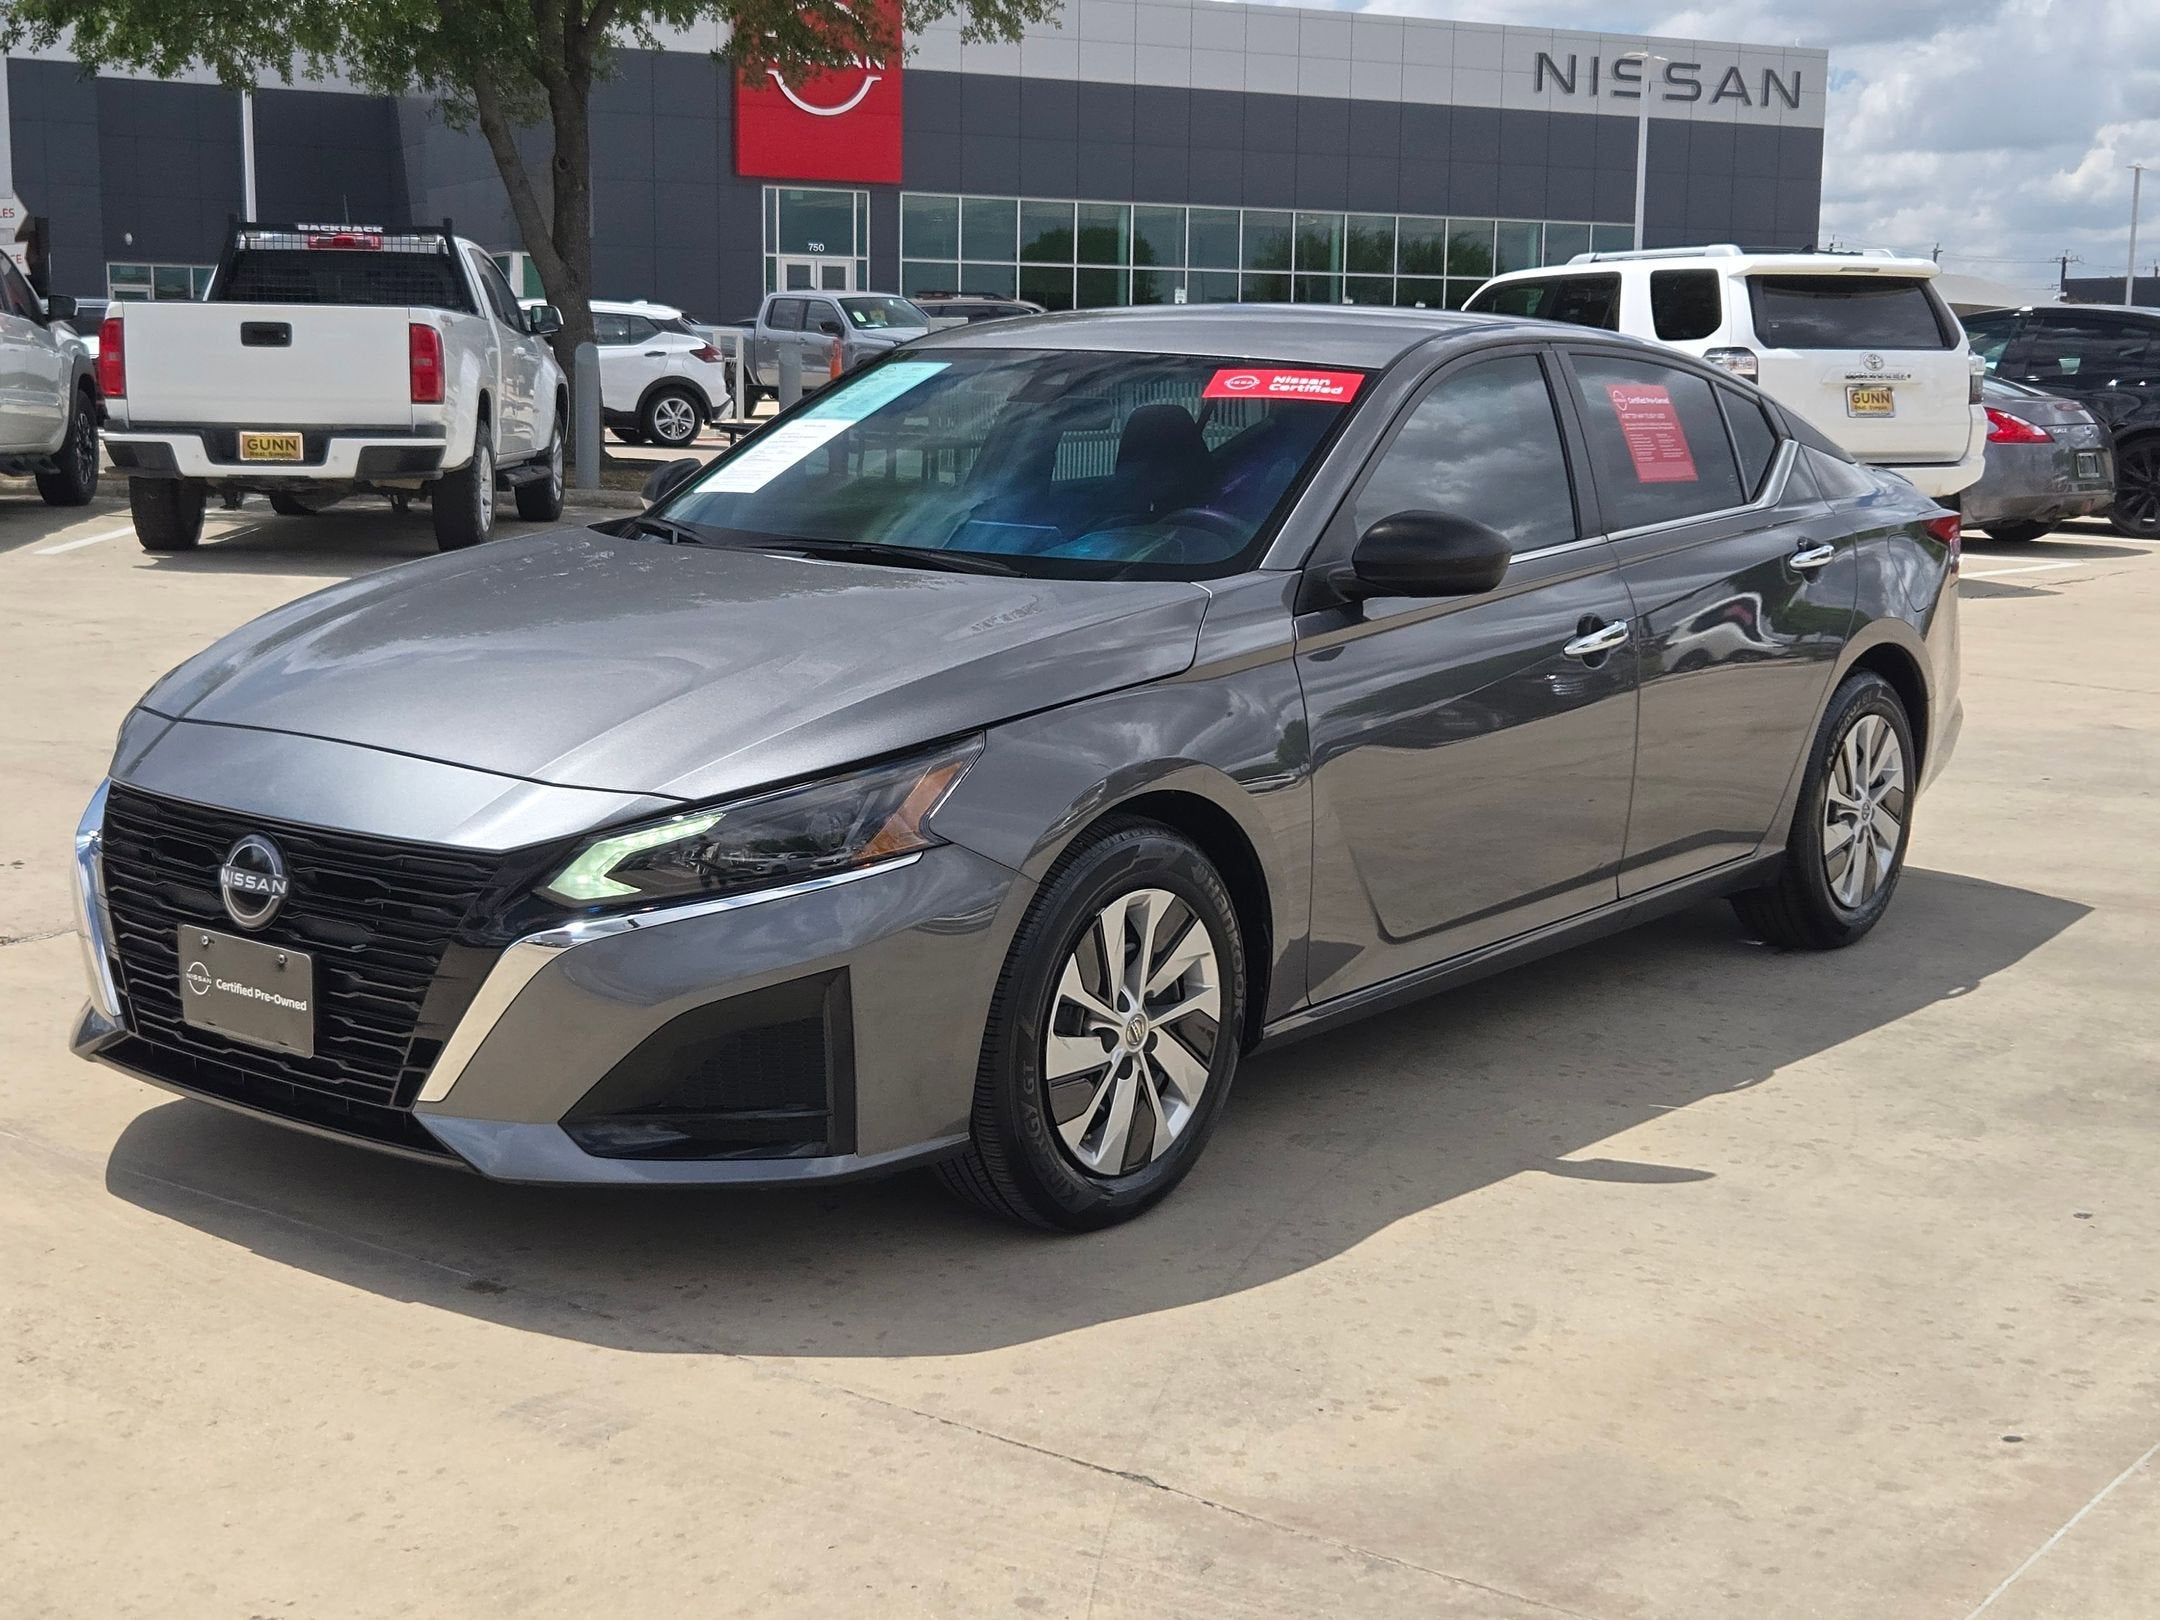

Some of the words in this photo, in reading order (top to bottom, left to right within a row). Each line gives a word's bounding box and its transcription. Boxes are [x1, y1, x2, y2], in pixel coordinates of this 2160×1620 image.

[1534, 52, 1802, 109] NISSAN
[297, 223, 385, 234] BACKRACK
[808, 242, 825, 252] 750
[1272, 375, 1331, 386] Nissan
[1268, 383, 1344, 395] Certified
[1852, 392, 1890, 404] GUNN
[247, 438, 297, 451] GUNN
[221, 867, 288, 895] NISSAN
[186, 972, 212, 985] NISSAN
[216, 978, 253, 998] Certified
[255, 988, 307, 1012] Pre-Owned
